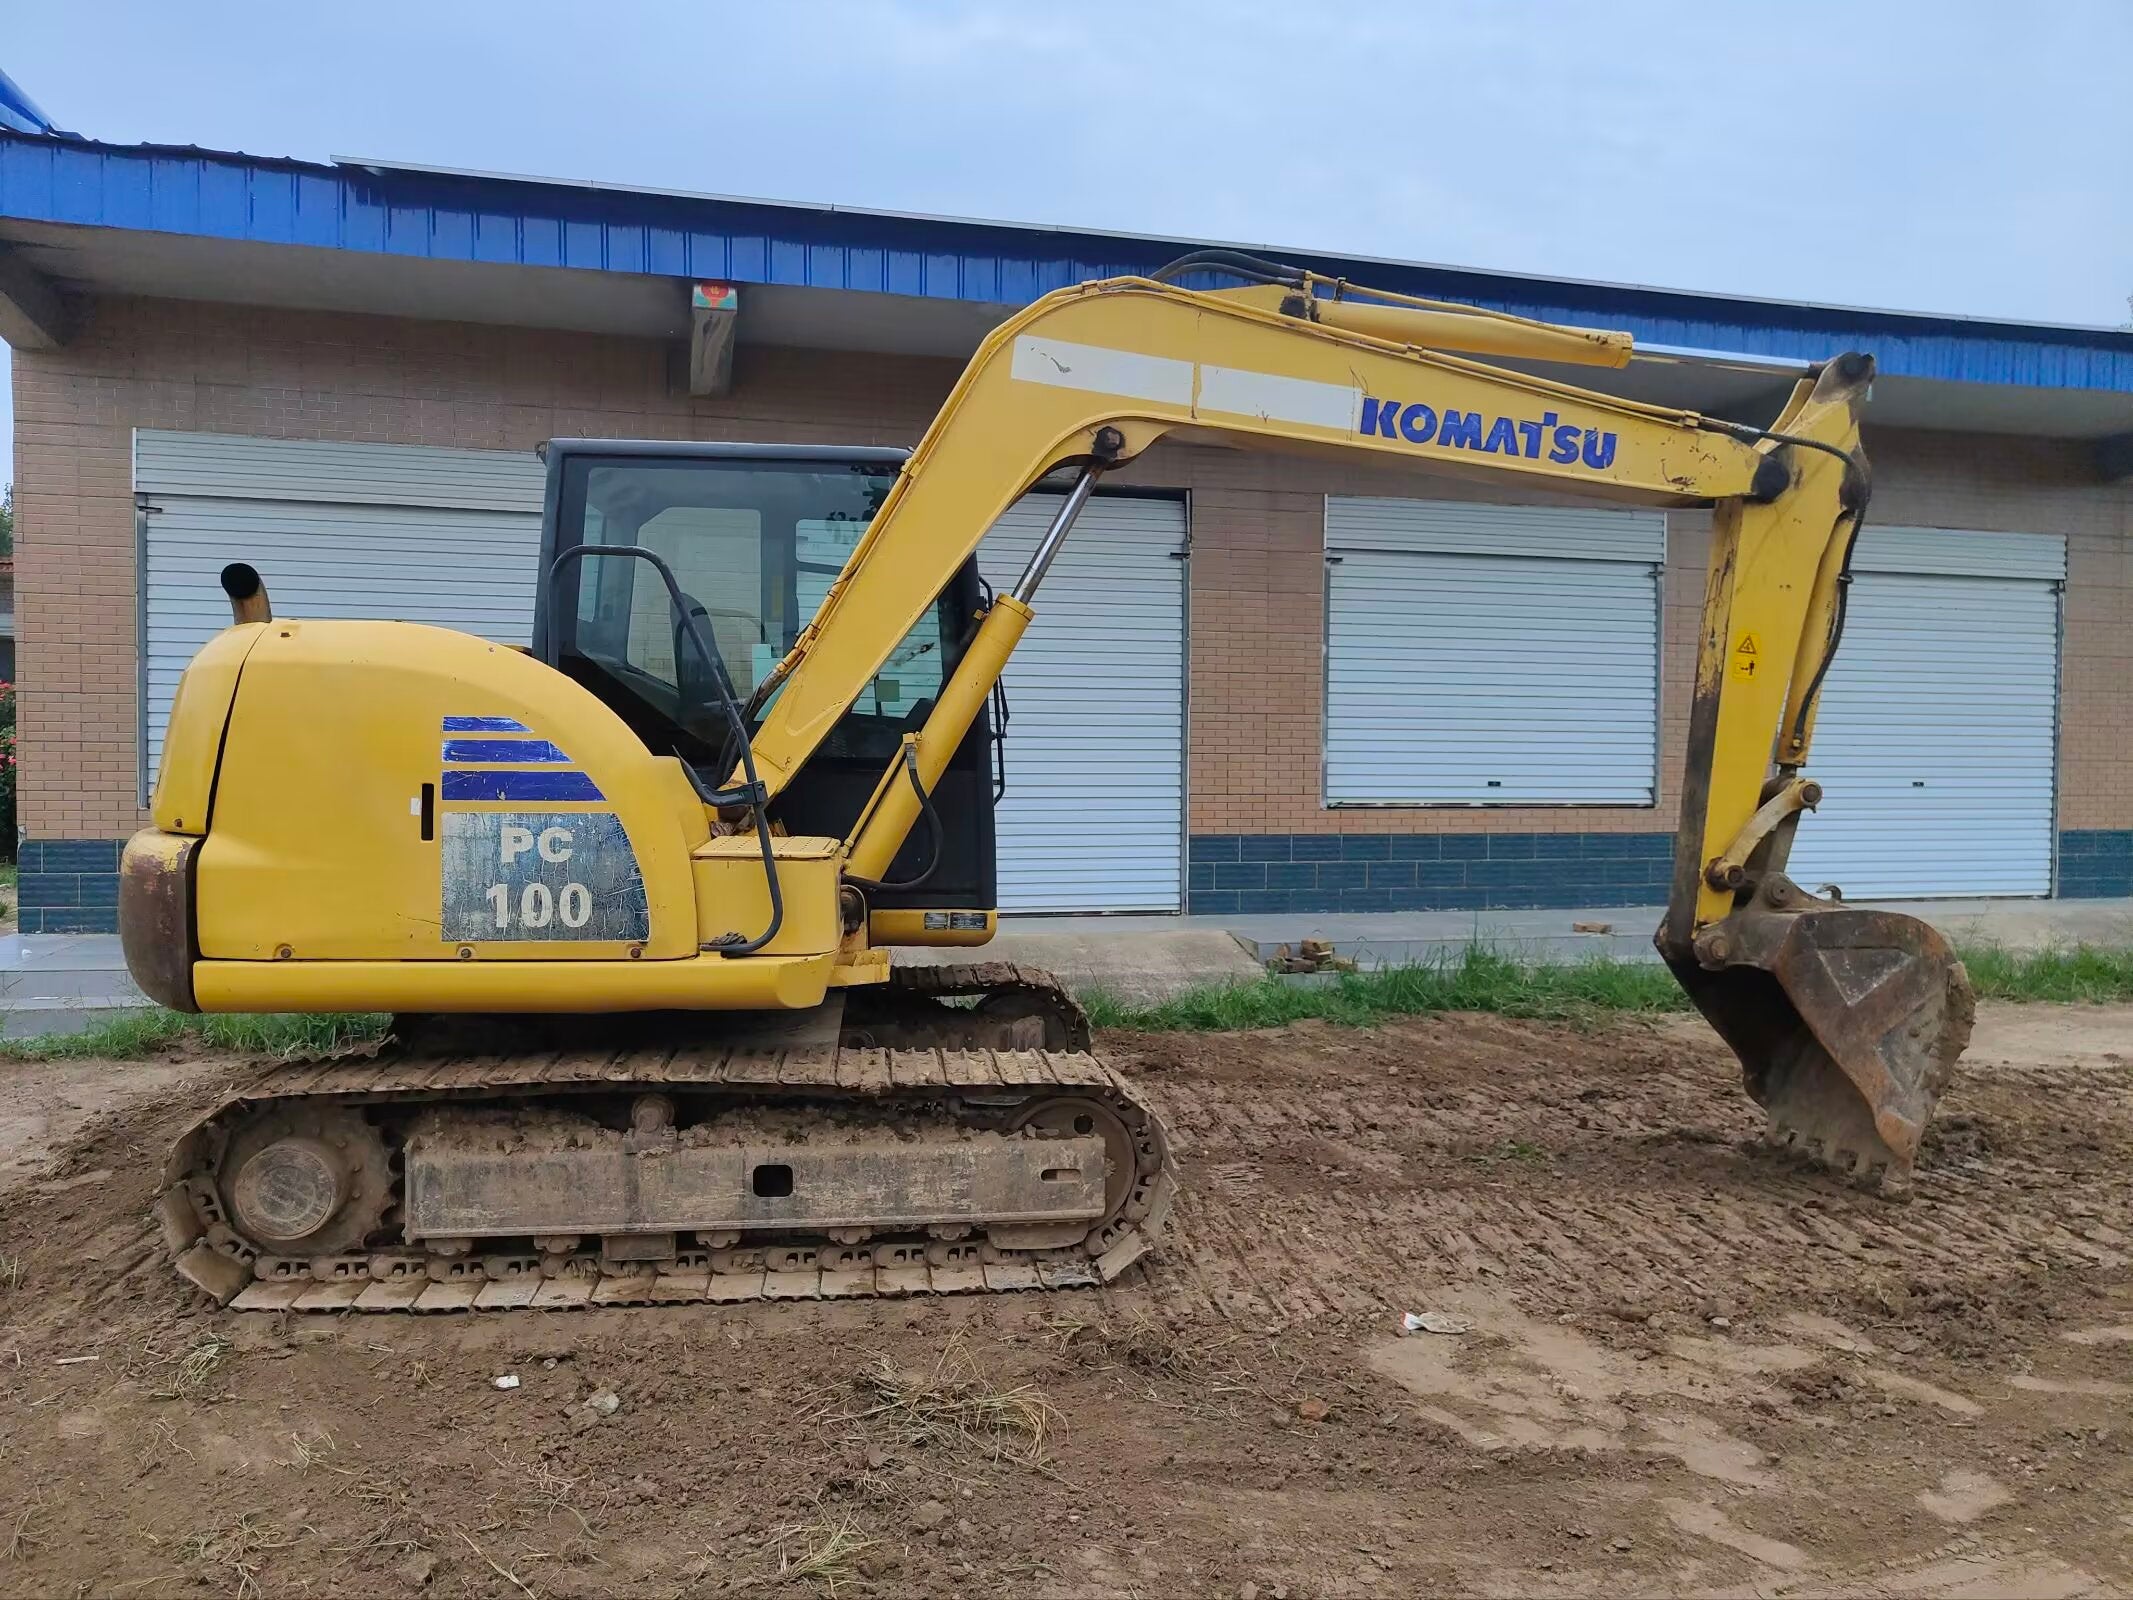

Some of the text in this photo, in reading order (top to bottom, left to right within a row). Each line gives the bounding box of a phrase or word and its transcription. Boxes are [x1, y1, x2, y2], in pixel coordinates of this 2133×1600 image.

[1359, 397, 1618, 470] KOMATSU
[500, 826, 574, 863] PC
[485, 882, 592, 928] 100
